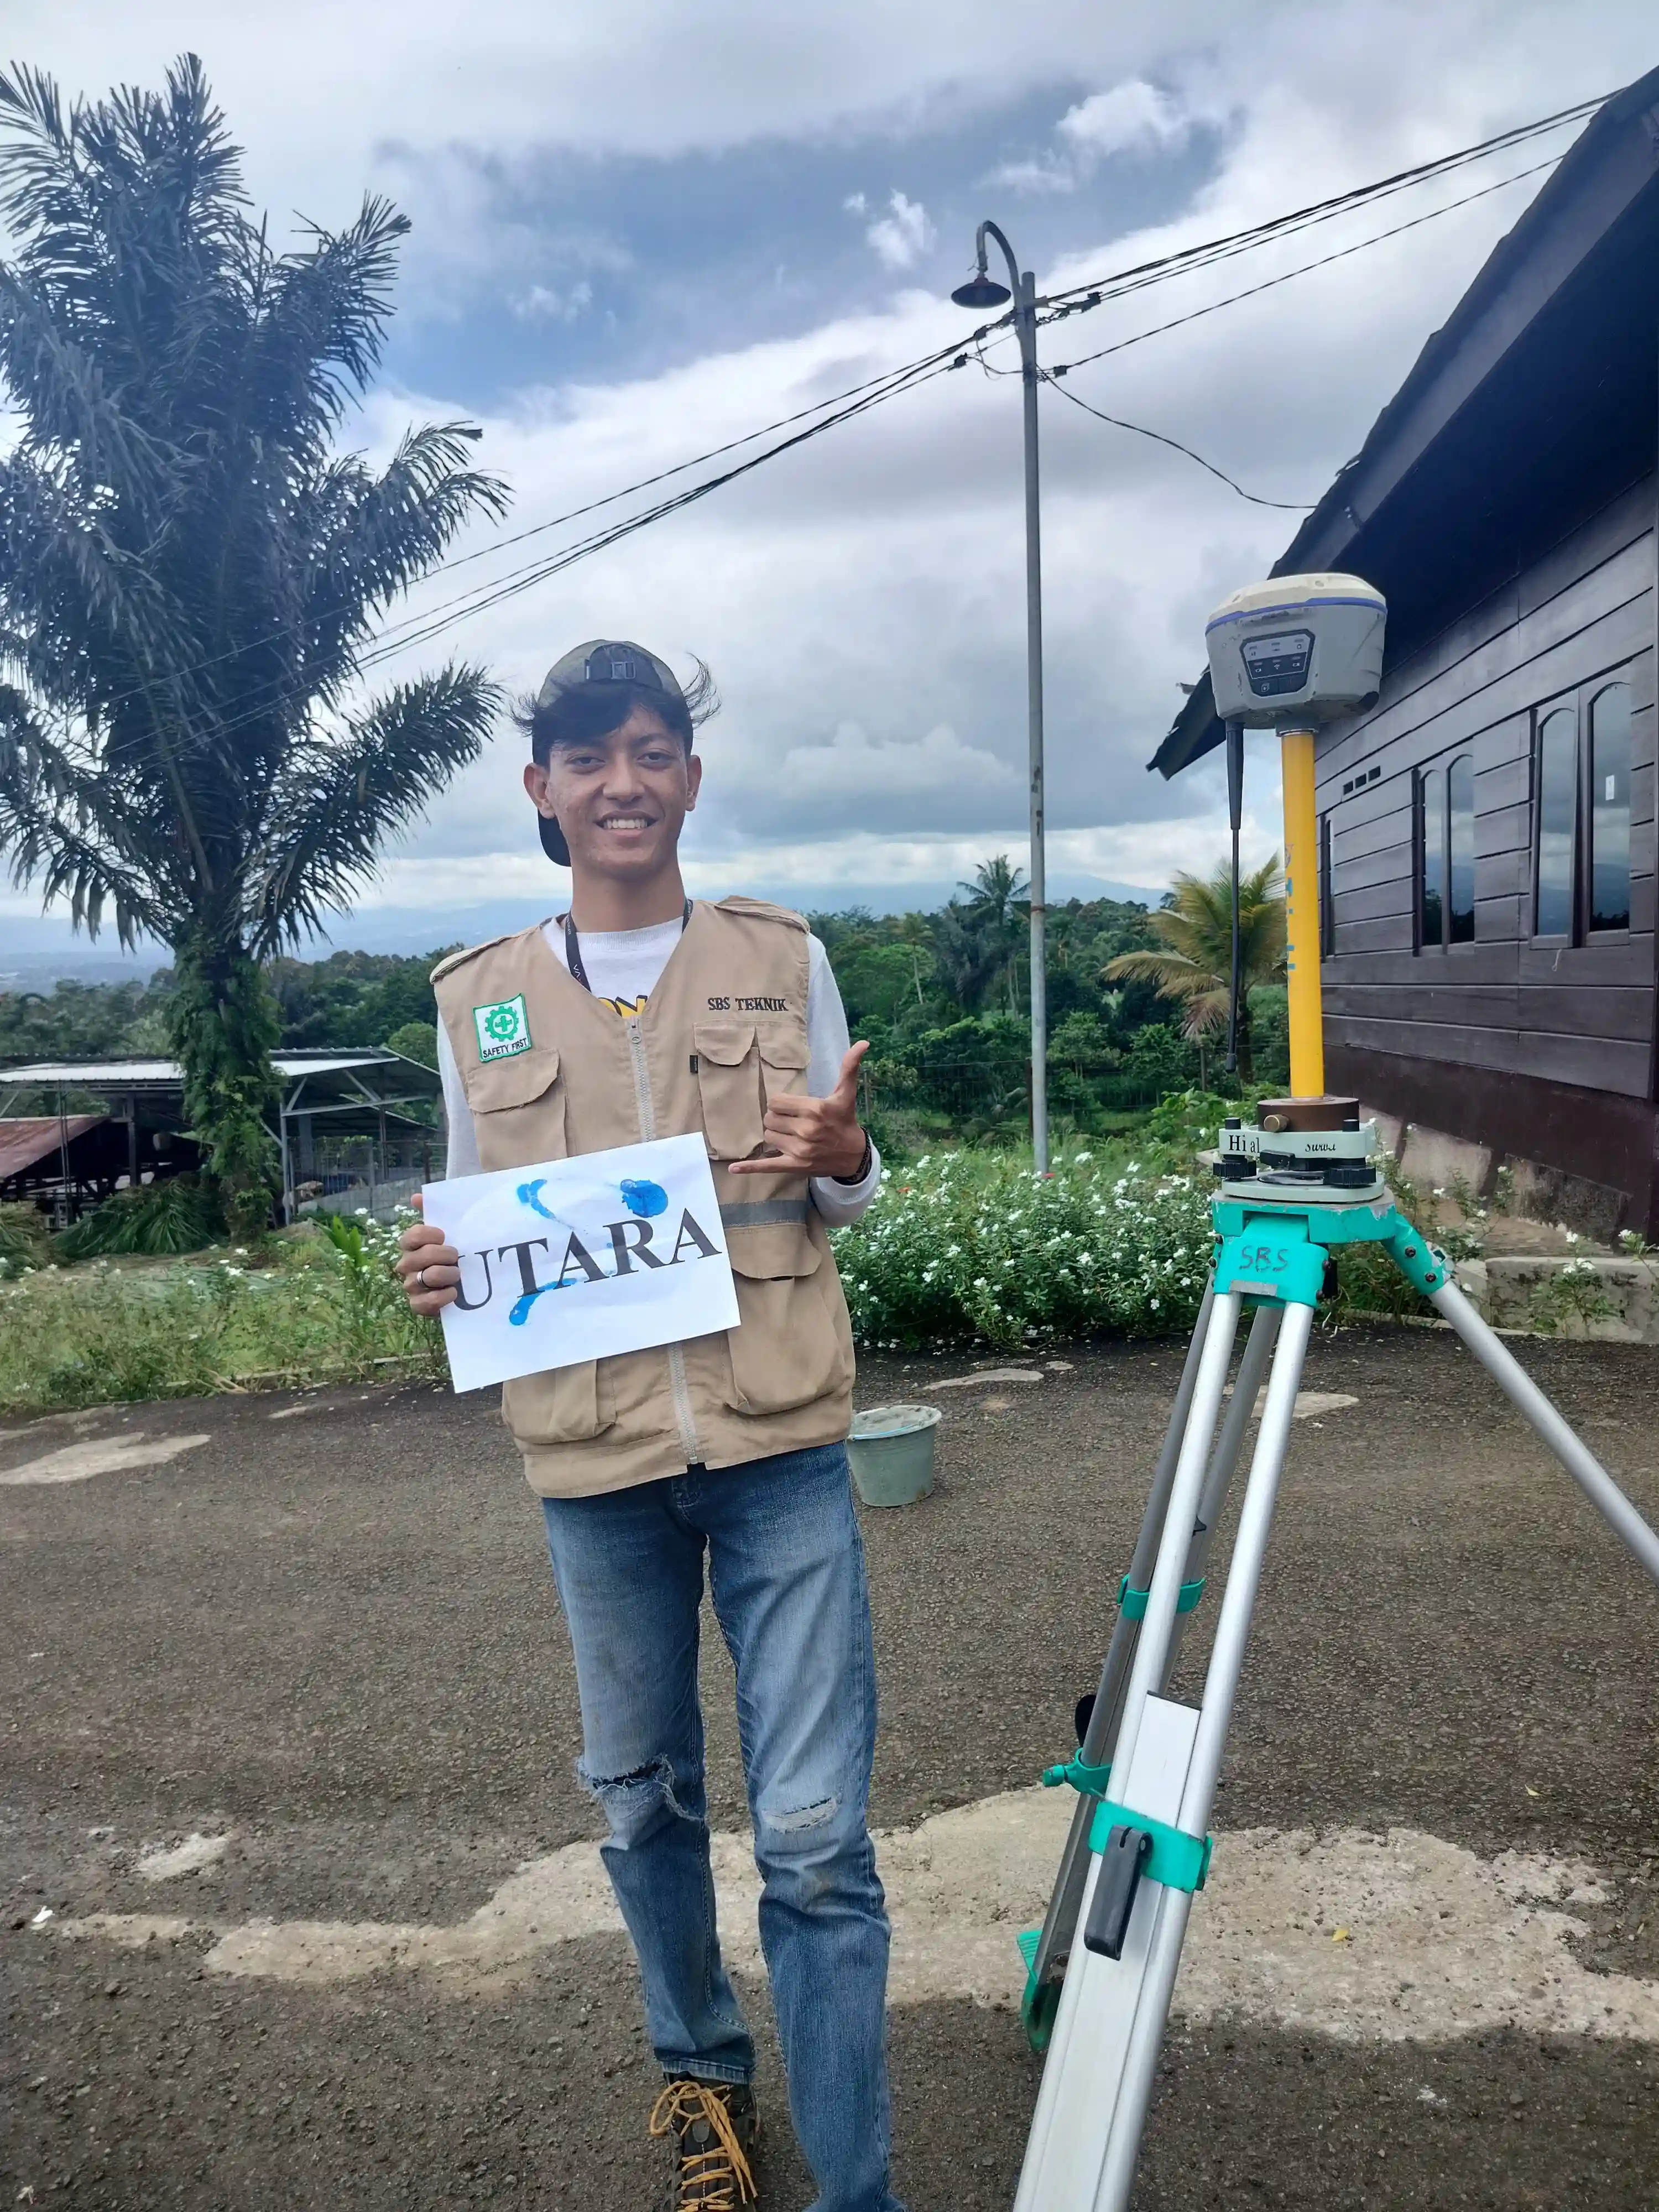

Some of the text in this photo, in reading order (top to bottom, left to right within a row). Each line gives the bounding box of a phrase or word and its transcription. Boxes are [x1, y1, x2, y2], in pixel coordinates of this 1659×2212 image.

[707, 997, 789, 1011] SBS TEKNIK
[483, 1038, 527, 1058] SAFETY FIRST
[452, 1207, 722, 1311] UTARA
[1239, 1245, 1288, 1272] SBS
